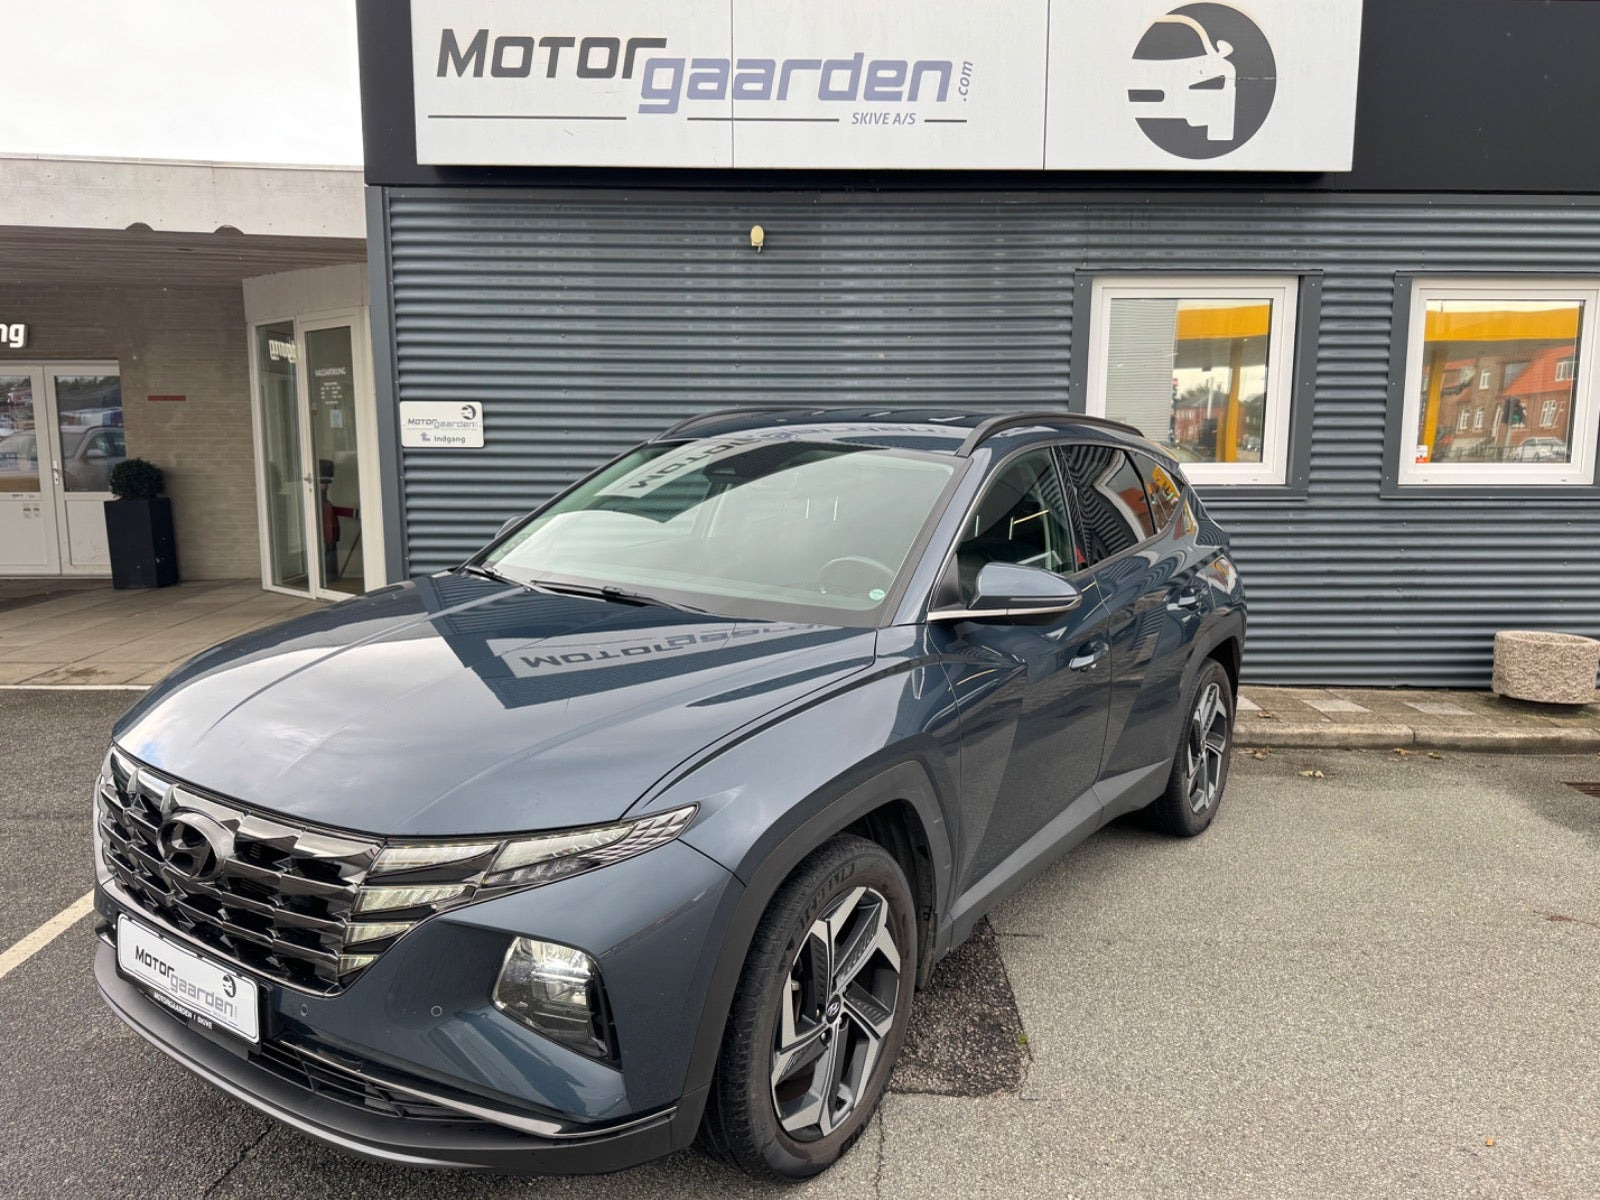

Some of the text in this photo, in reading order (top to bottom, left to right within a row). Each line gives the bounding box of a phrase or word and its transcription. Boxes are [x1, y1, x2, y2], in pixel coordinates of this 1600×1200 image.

[850, 112, 917, 126] SKIVE A/S
[434, 435, 466, 443] Indgang
